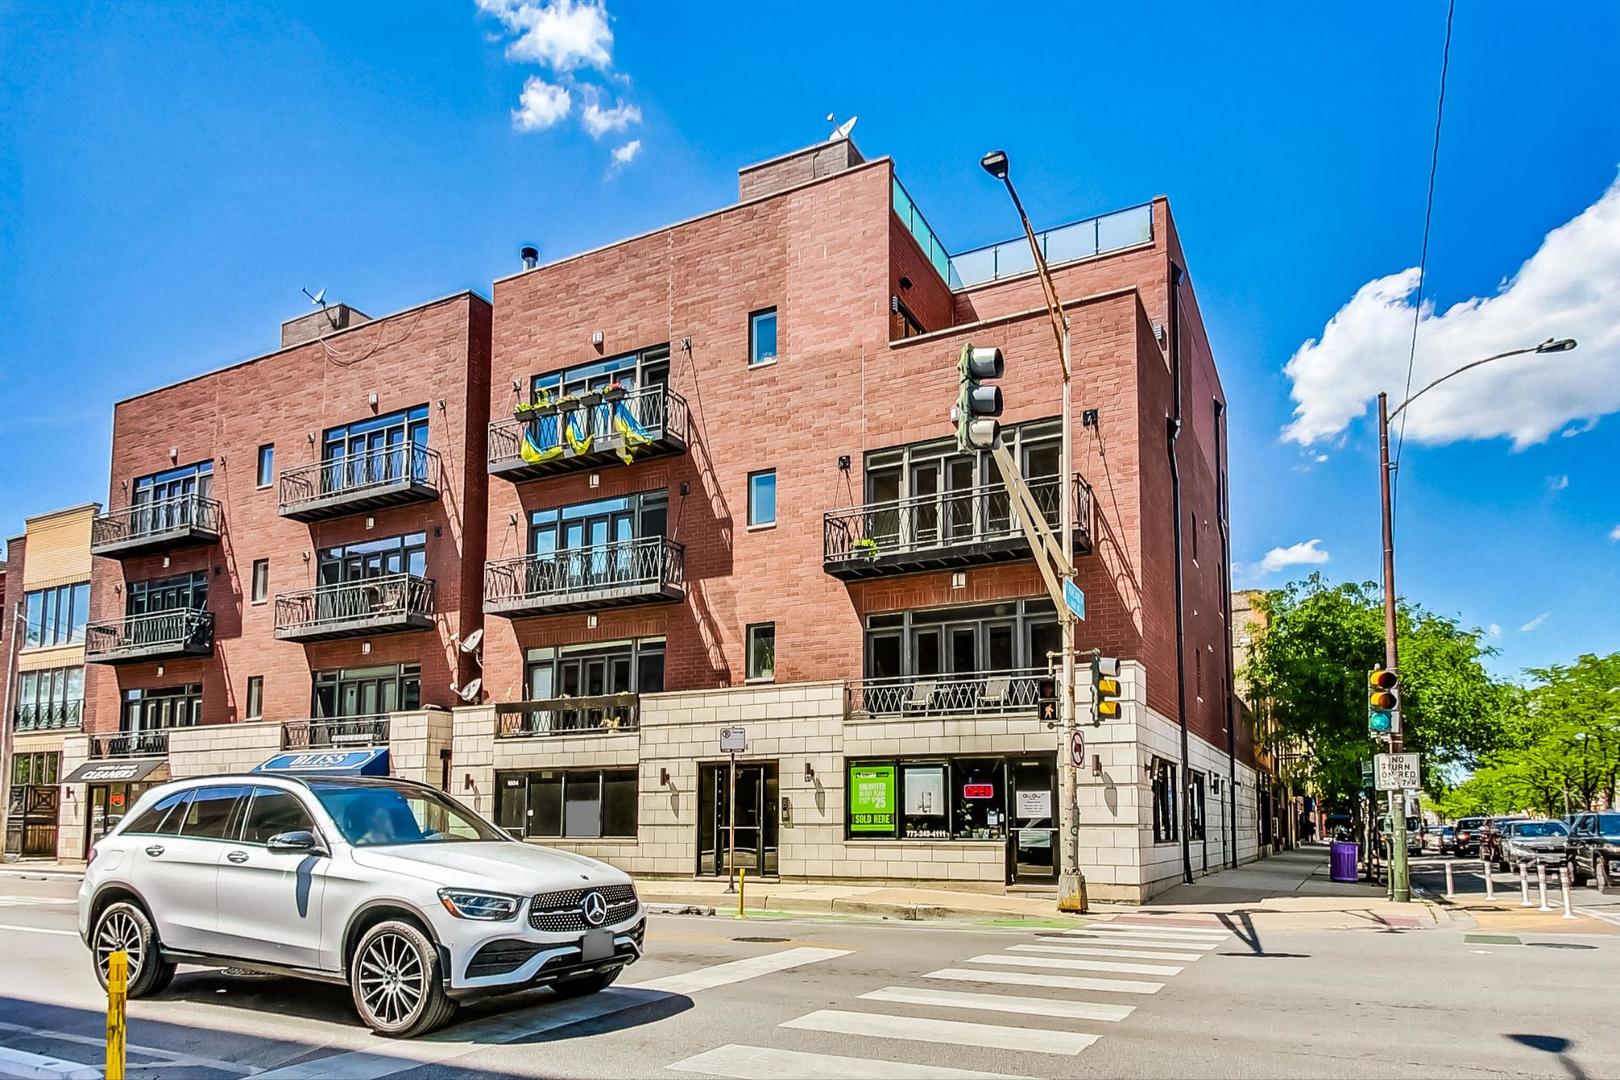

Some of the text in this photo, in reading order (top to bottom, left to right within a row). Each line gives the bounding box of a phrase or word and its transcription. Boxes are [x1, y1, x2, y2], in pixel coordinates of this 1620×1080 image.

[290, 753, 349, 765] BLISS
[80, 769, 138, 780] CLEANERS
[855, 814, 890, 824] SOLD HERE
